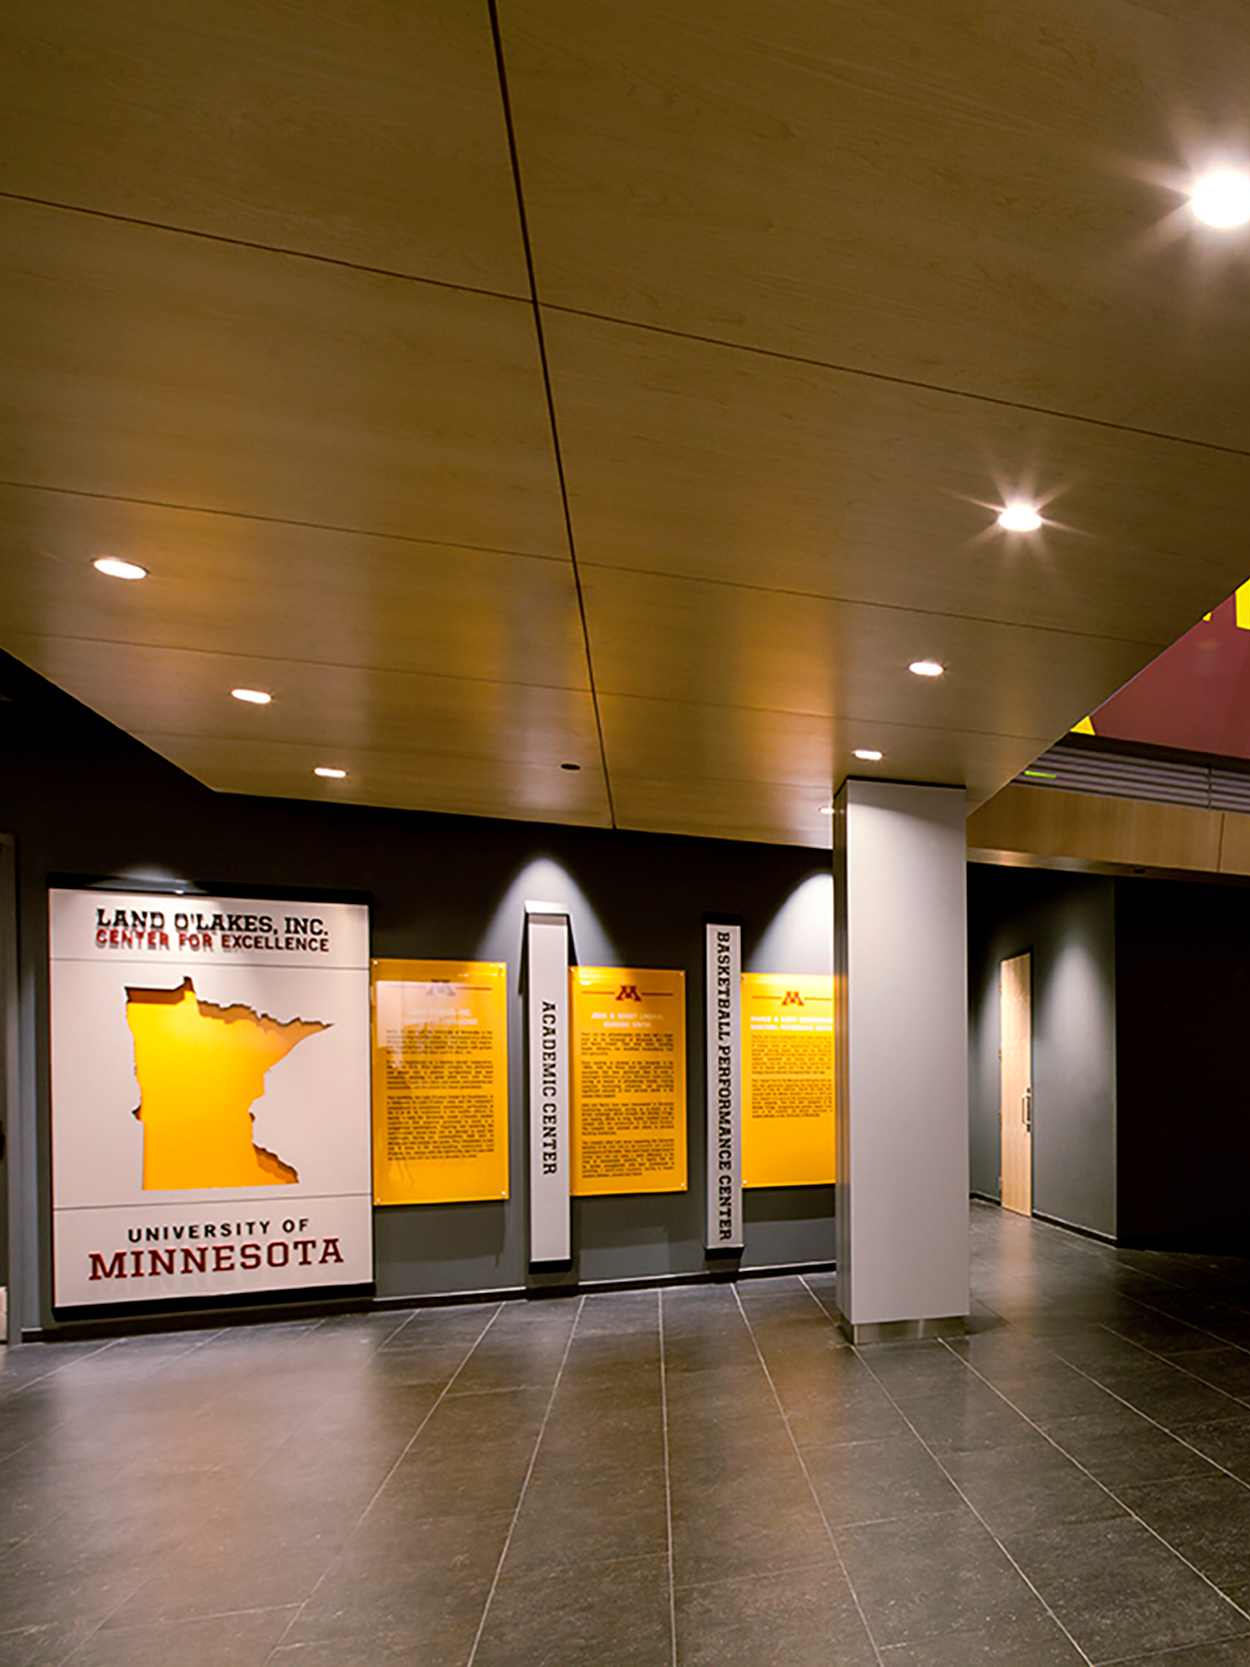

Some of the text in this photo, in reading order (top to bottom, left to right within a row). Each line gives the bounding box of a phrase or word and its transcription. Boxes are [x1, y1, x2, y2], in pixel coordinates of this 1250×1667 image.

[96, 908, 329, 936] LAND O'LAKES, INC.
[95, 929, 330, 952] CENTER FOR EXCELLENCE
[541, 1000, 558, 1175] ACADEMIC CENTER
[716, 931, 732, 1241] BASKETBALL PERFORMANCE CENTER
[127, 1218, 309, 1243] UNIVERSITY OF
[88, 1238, 344, 1281] MINNESOTA
